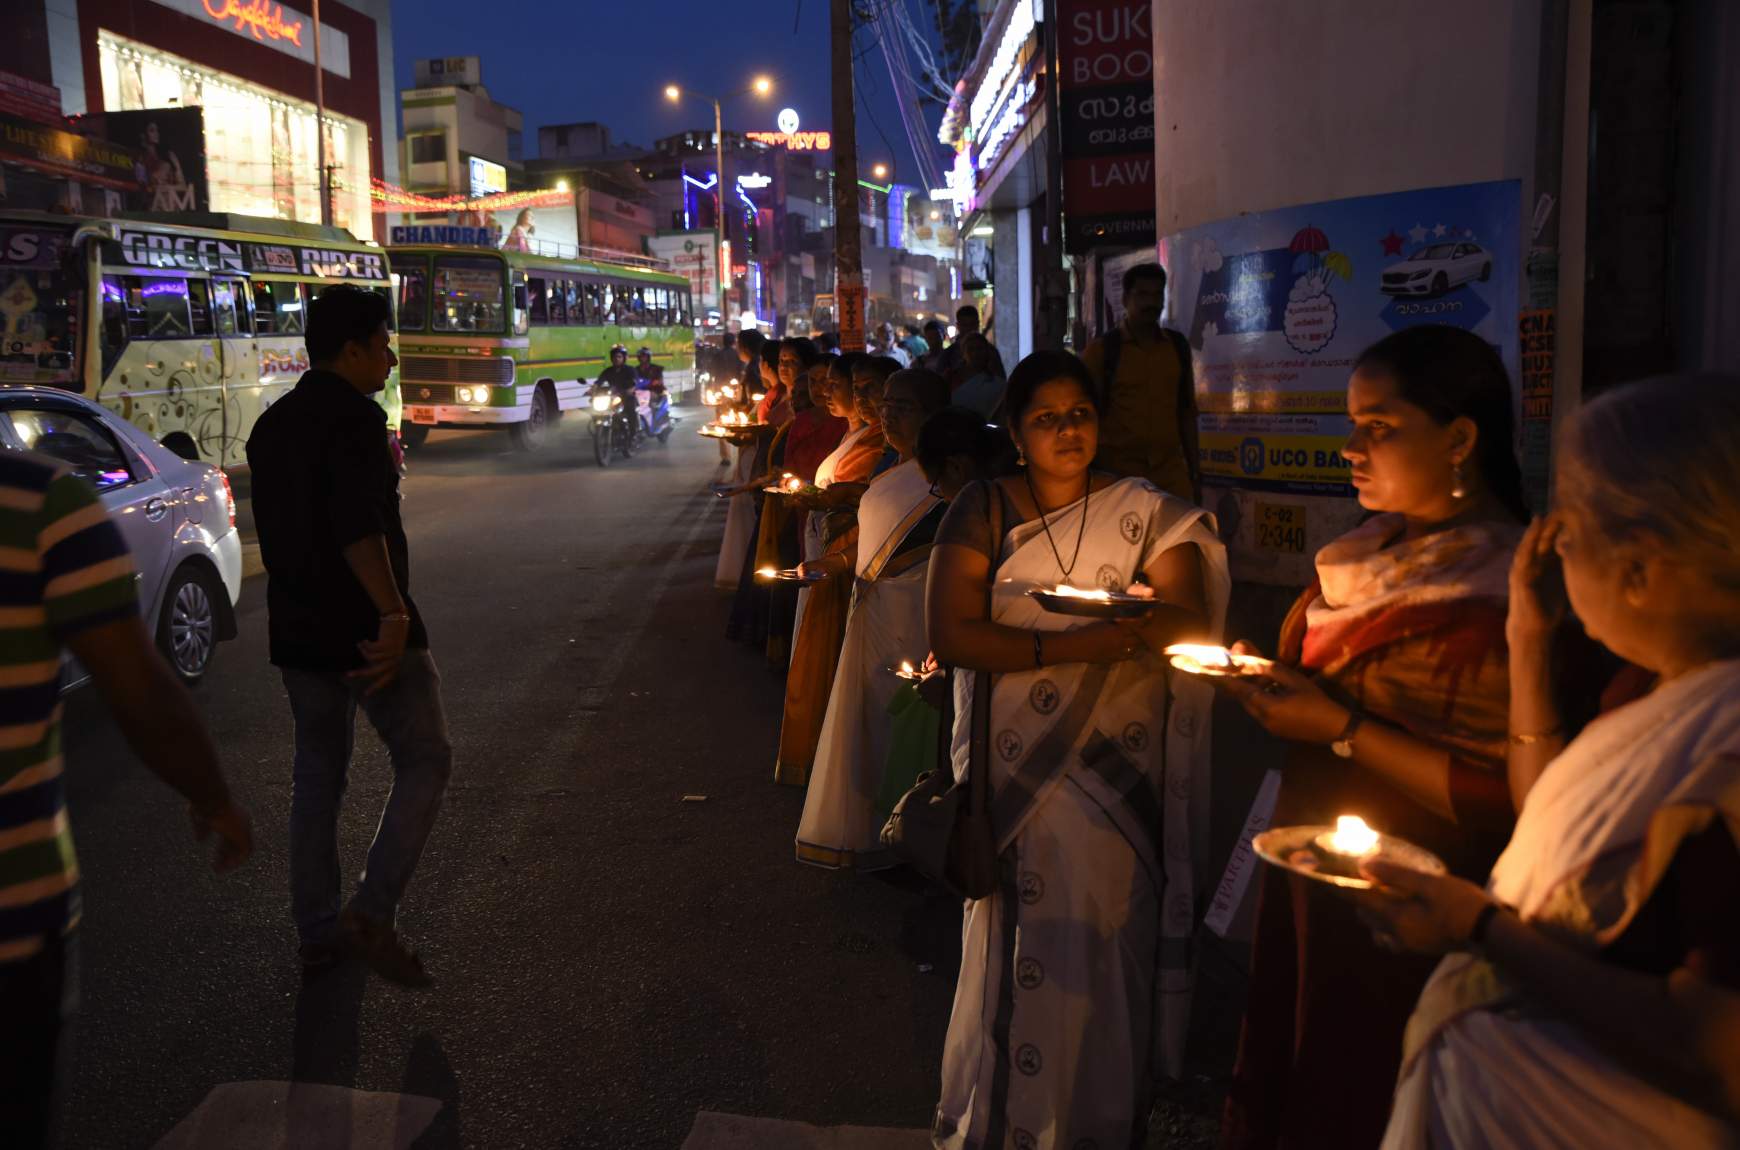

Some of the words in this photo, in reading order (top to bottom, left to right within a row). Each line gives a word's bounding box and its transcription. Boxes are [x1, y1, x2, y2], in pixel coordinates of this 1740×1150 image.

[1073, 50, 1152, 83] BOO
[1090, 160, 1151, 188] LAW
[392, 225, 492, 245] CHANDRA
[121, 232, 243, 271] GREEN
[301, 248, 384, 279] RIDER
[1270, 448, 1308, 467] UCO
